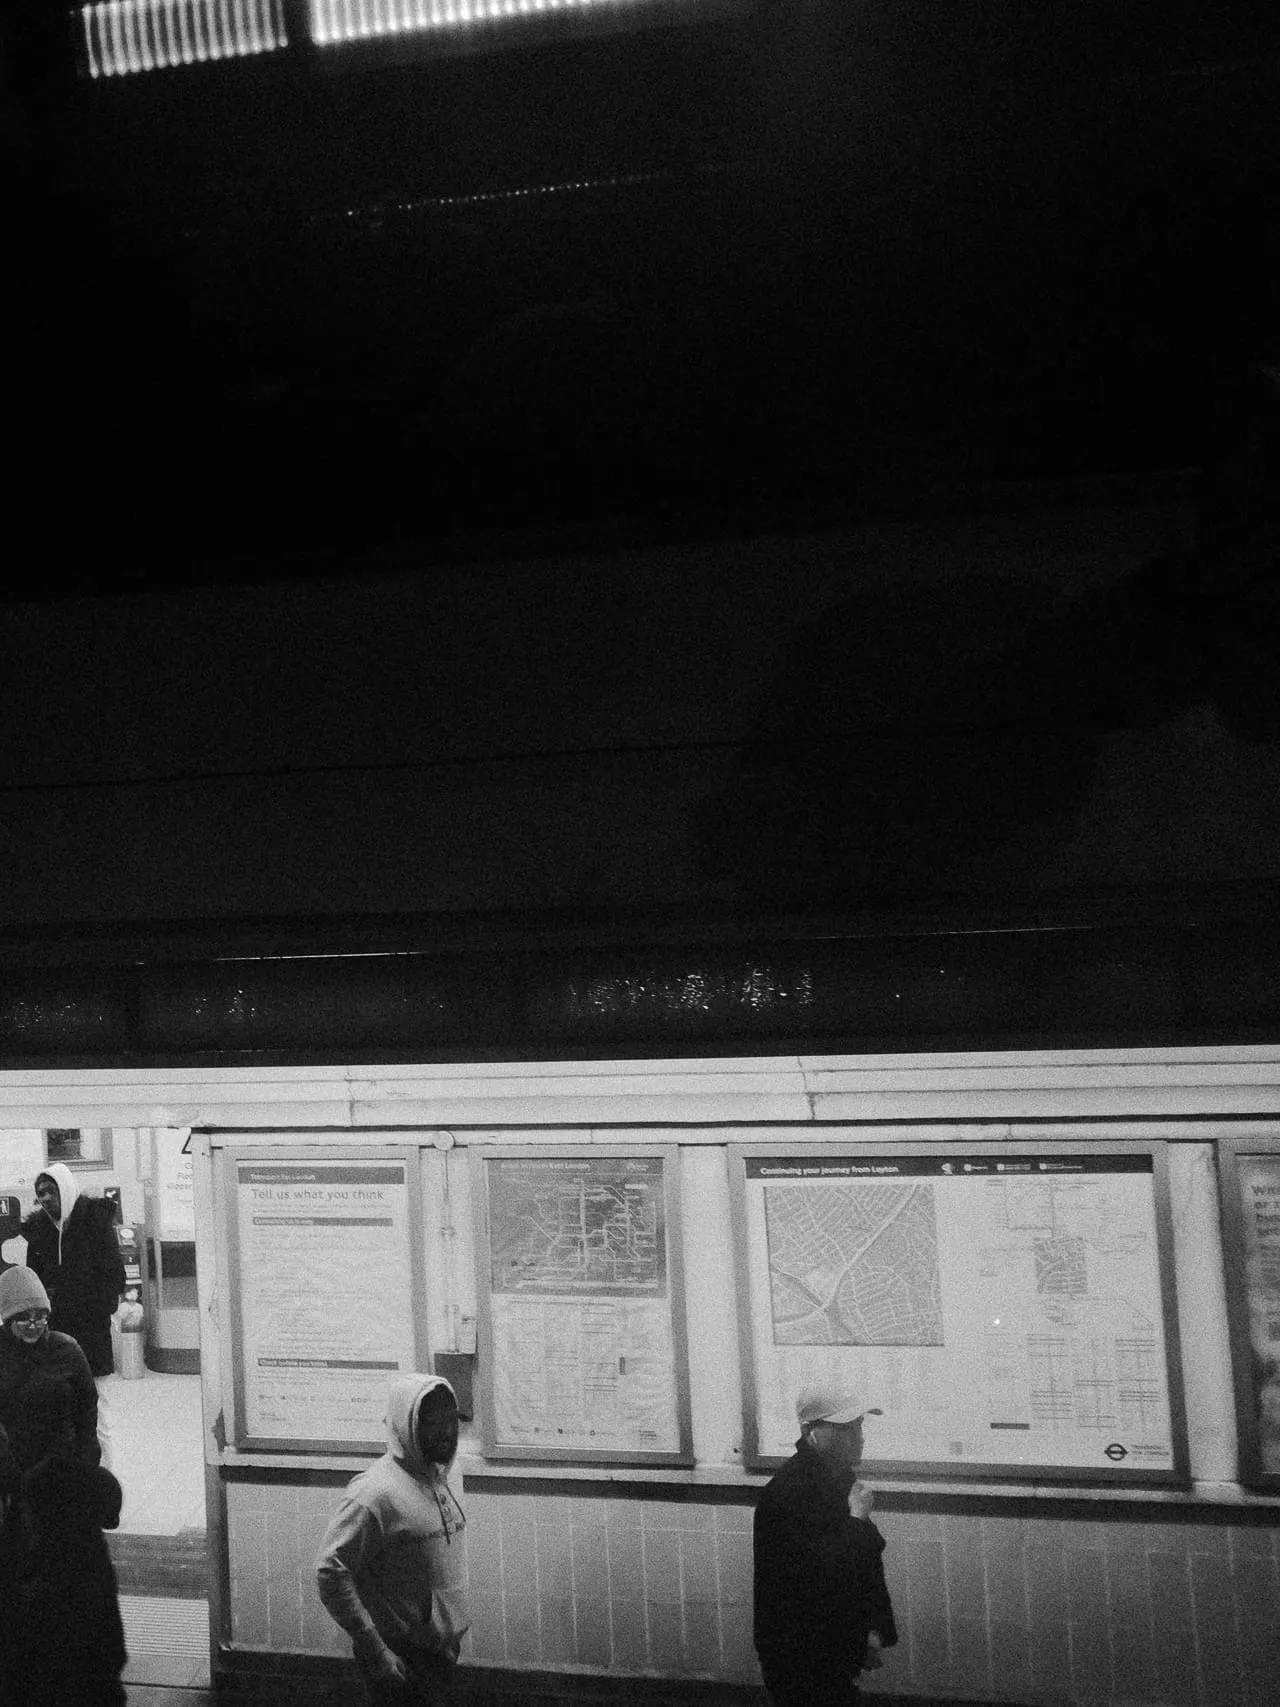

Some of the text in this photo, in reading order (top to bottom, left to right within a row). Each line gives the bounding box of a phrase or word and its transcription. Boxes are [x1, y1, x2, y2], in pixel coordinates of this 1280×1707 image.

[760, 1165, 898, 1176] Continuing your journey from Leyton
[251, 1188, 384, 1202] Tell us what you think
